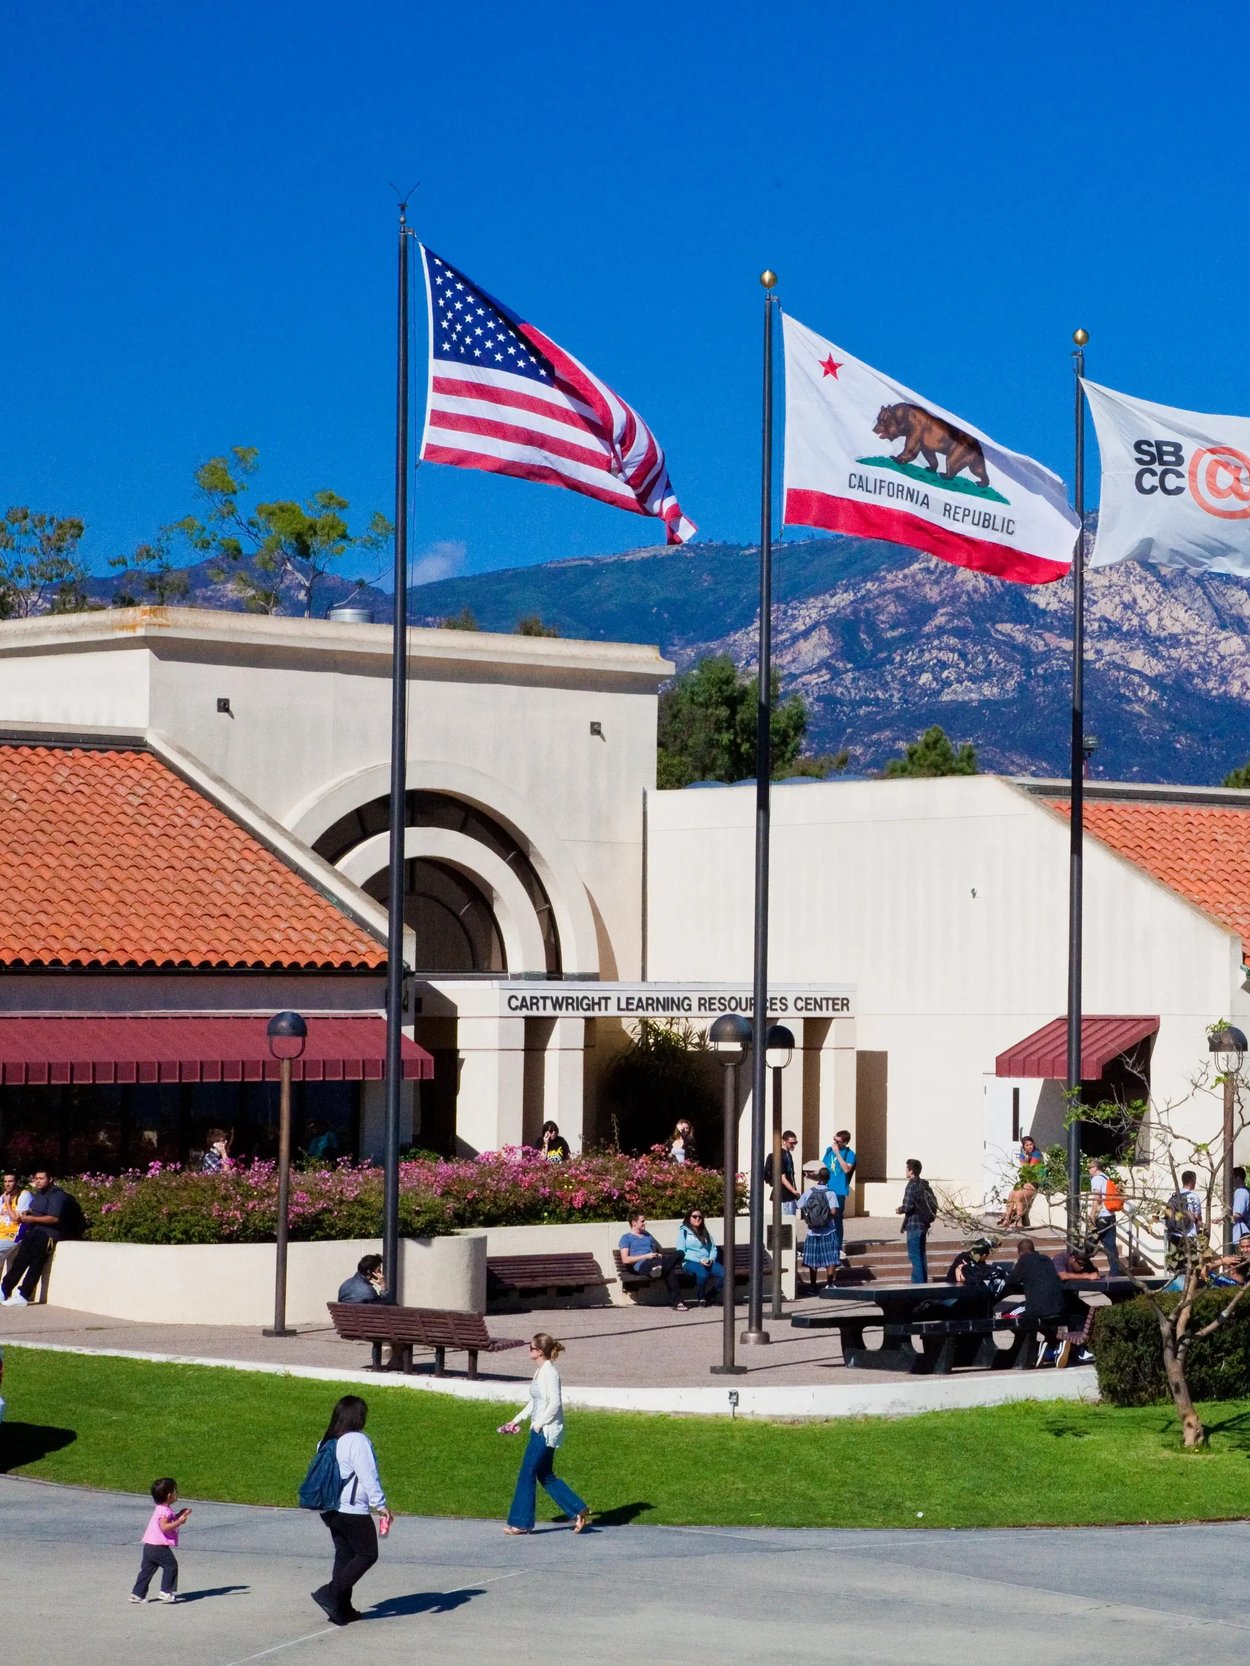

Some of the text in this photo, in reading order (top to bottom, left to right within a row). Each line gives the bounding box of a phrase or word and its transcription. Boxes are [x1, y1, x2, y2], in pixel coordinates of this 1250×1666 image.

[1133, 439, 1185, 467] SB
[1134, 467, 1187, 496] CC
[847, 472, 1016, 536] CALIFORNIA REPUBLIC
[507, 994, 850, 1012] CARTWRIGHT LEARNING RESOUES CENTER
